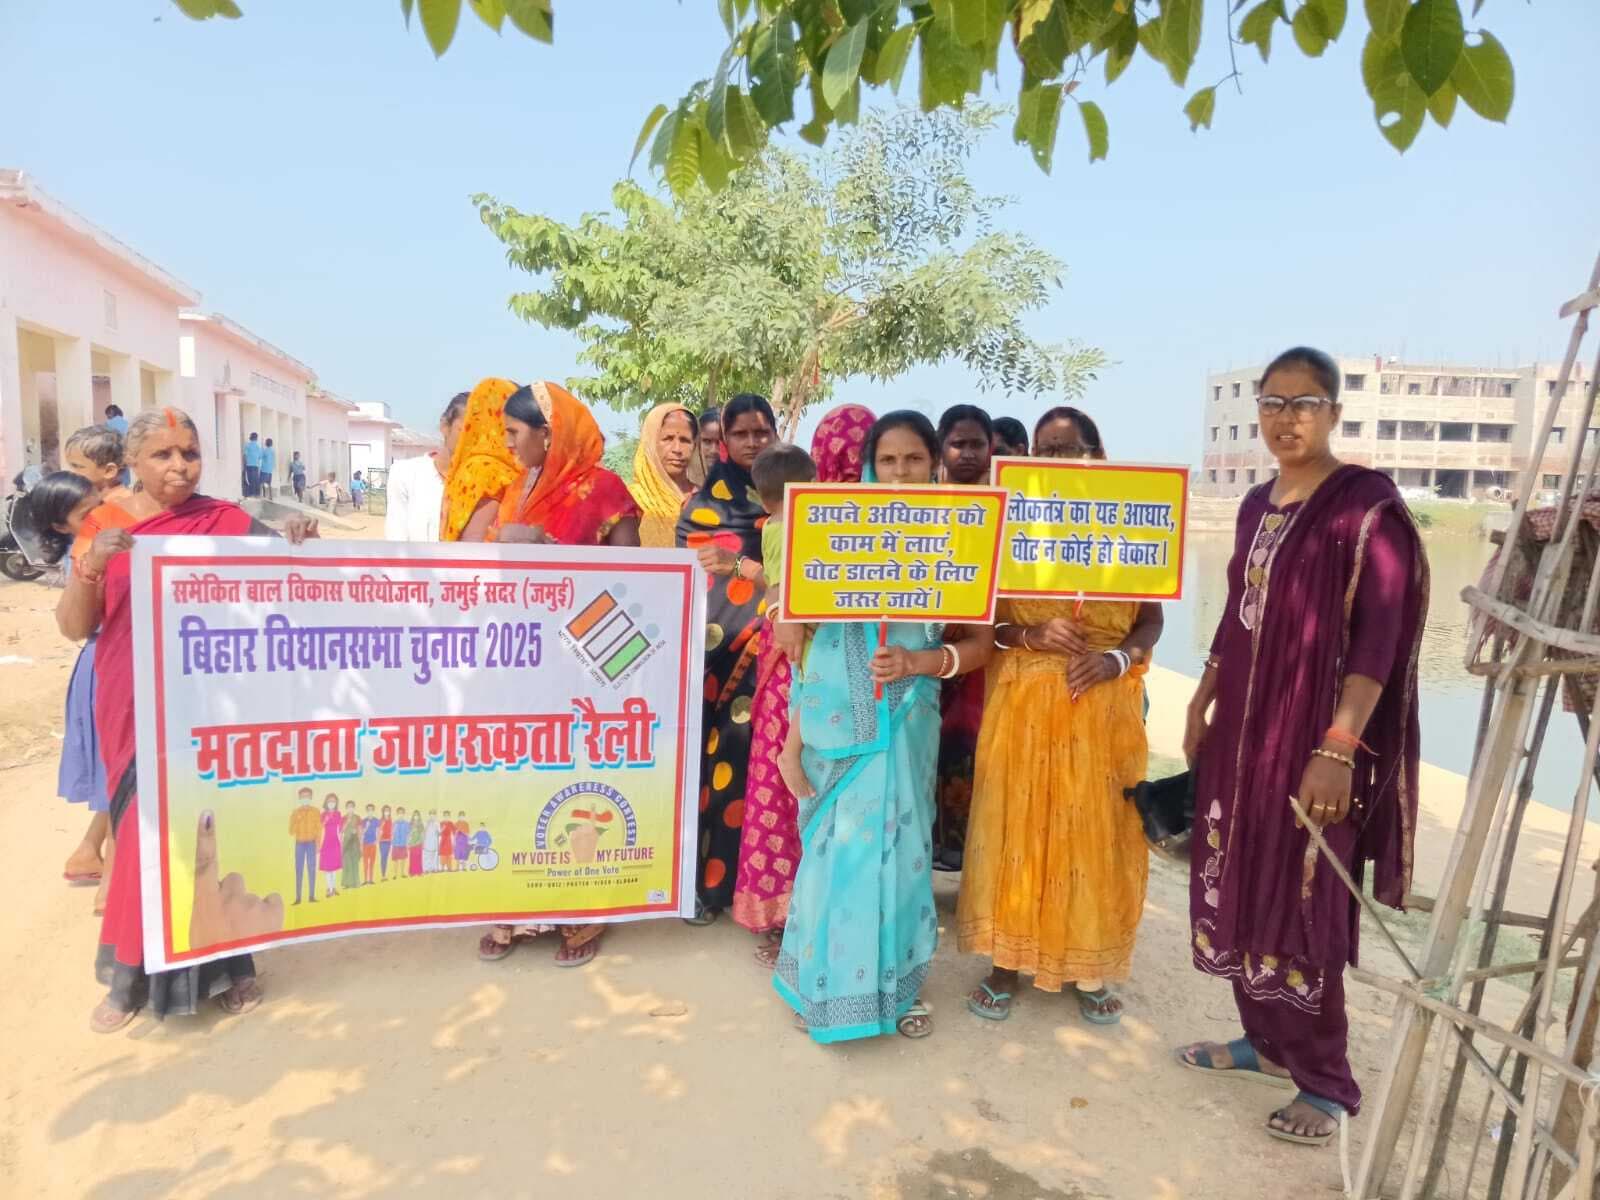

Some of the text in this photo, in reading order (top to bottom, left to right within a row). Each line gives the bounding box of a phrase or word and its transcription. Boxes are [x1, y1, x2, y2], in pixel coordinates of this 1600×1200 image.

[808, 501, 987, 526] अपने अधिकार को
[1069, 501, 1091, 523] का
[1095, 502, 1118, 524] यह
[830, 535, 876, 552] काम
[881, 530, 902, 552] में
[1012, 532, 1040, 562] वोट
[1044, 540, 1056, 562] न
[1060, 534, 1094, 565] कोई
[1097, 535, 1114, 563] हो
[804, 559, 979, 582] वोट डालने के लिए
[171, 573, 575, 612] समेकित बाल विकास परियोजना, जमुई सदर (जमुई)
[179, 615, 258, 675] बिहार
[263, 614, 404, 672] विधानसभा
[409, 626, 479, 684] चुनाव
[485, 622, 542, 668] 2025
[191, 718, 363, 785] मतदाता
[571, 697, 658, 766] रैली
[536, 782, 636, 847] VOTER AWARENESS CONTEST
[512, 847, 654, 865] MY VOTE IS MY FUTURE
[547, 865, 619, 877] Power of One Vote
